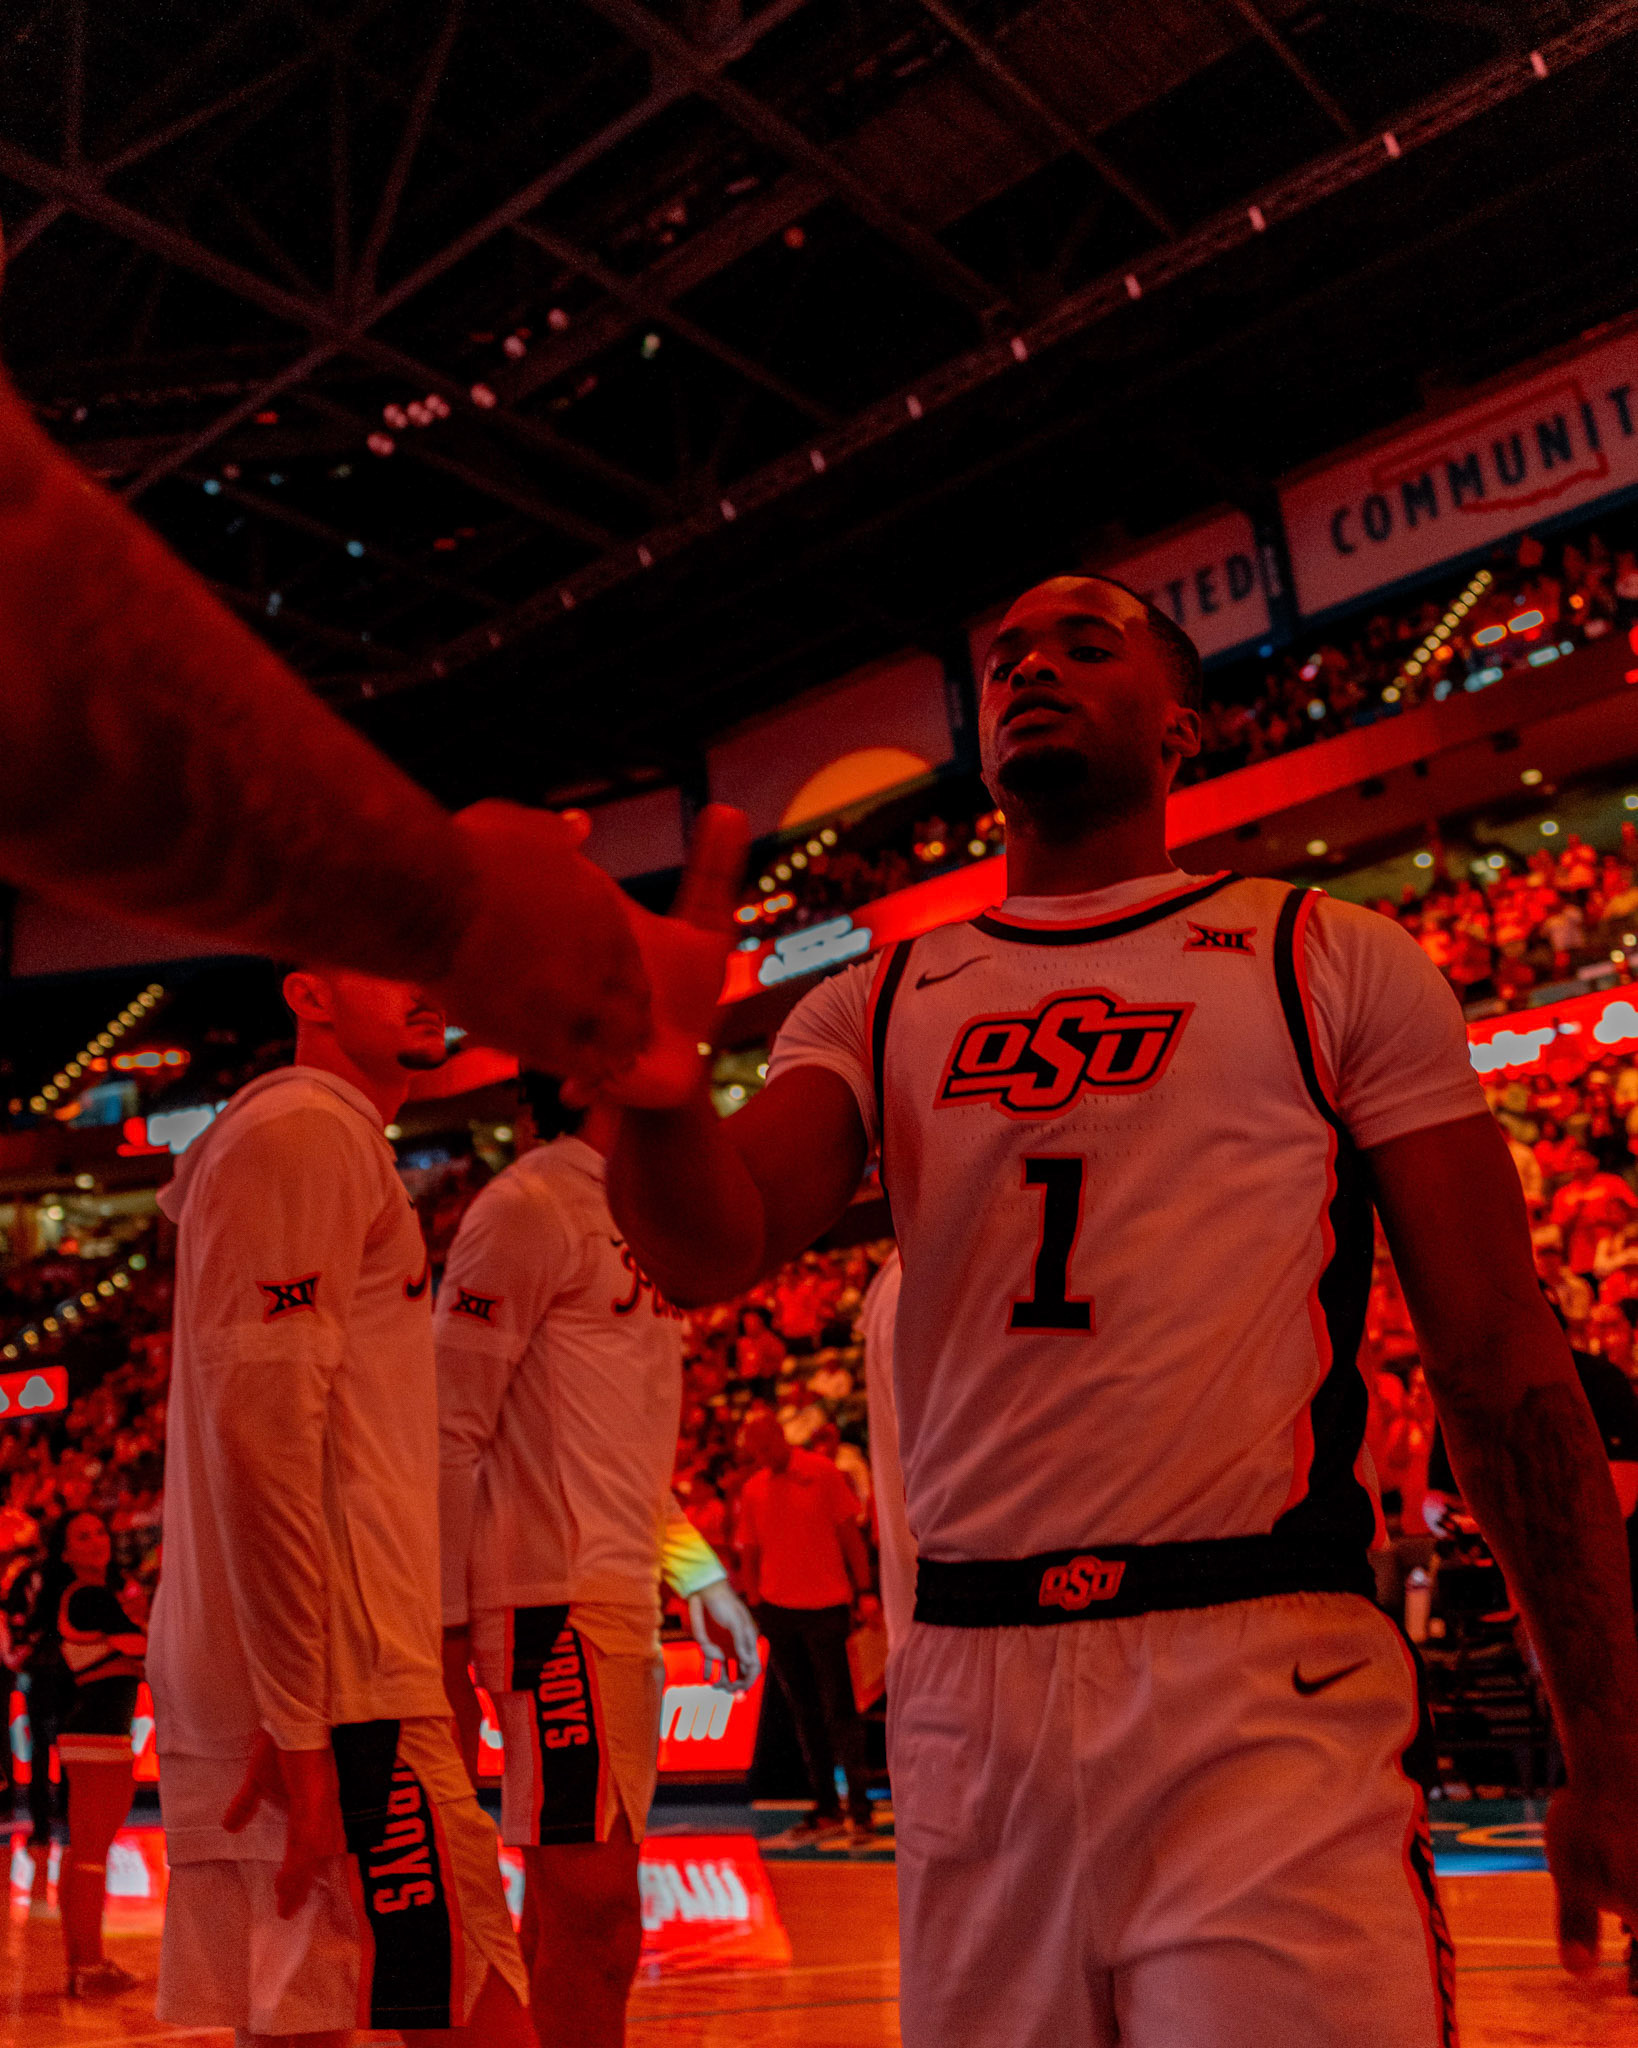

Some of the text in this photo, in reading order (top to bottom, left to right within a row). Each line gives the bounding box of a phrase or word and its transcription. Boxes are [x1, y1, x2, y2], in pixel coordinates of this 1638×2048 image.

[1330, 385, 1632, 556] COMMUNIT
[1146, 554, 1255, 626] TED
[1187, 921, 1255, 954] XII
[934, 987, 1195, 1120] OSU
[1006, 1153, 1096, 1335] 1
[1038, 1554, 1127, 1612] OSU
